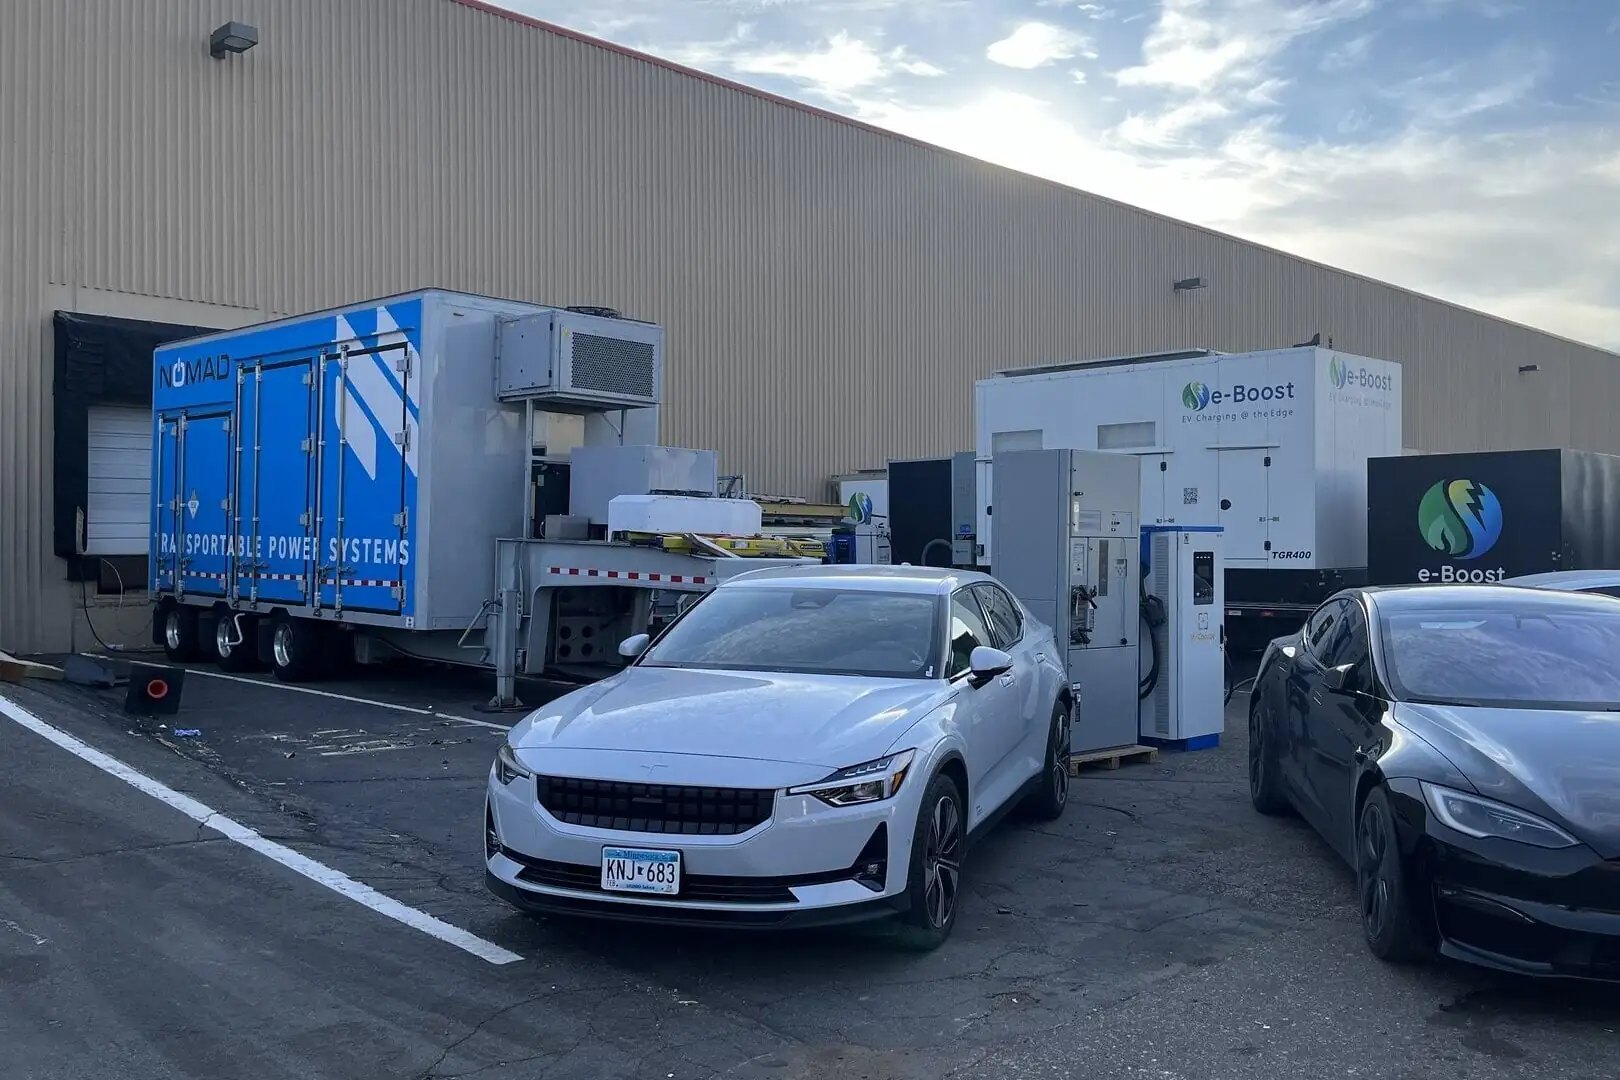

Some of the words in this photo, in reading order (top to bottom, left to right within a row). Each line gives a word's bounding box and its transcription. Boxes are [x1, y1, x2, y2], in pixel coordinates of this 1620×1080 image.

[160, 354, 230, 389] NOMAD
[1347, 367, 1392, 391] e-Boost
[1211, 382, 1294, 404] e-Boost
[1196, 412, 1237, 423] Charging
[1241, 411, 1249, 420] @
[154, 532, 262, 558] RASPORTABLE
[329, 537, 409, 566] SYSTEMS
[1272, 551, 1311, 559] TGR400
[1418, 565, 1505, 583] e-Boost
[607, 859, 635, 881] KNJ
[647, 863, 675, 884] 683
